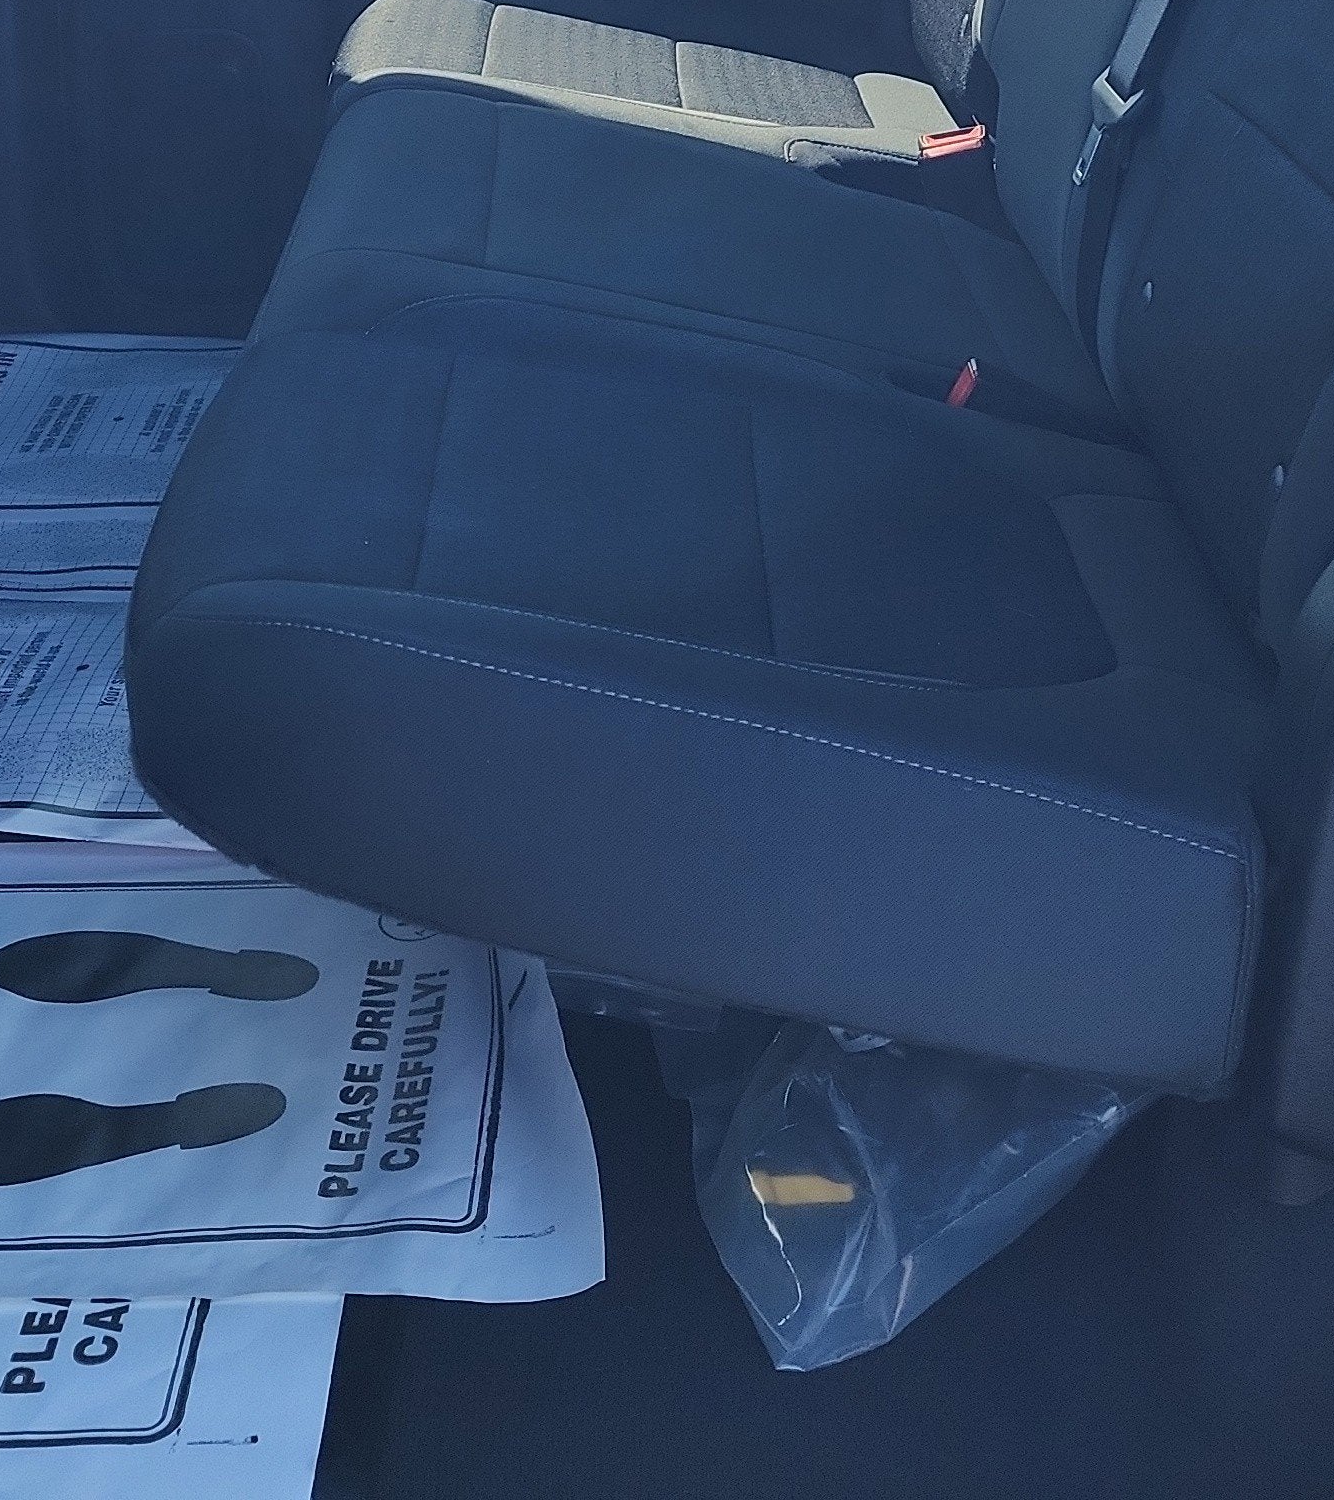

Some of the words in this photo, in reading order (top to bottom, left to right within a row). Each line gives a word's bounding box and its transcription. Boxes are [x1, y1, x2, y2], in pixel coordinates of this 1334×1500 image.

[97, 686, 122, 706] Your
[350, 959, 405, 1052] DRIVE
[379, 968, 451, 1172] CAREFULLY!
[317, 1062, 384, 1198] PLEASE
[72, 1297, 133, 1366] CA
